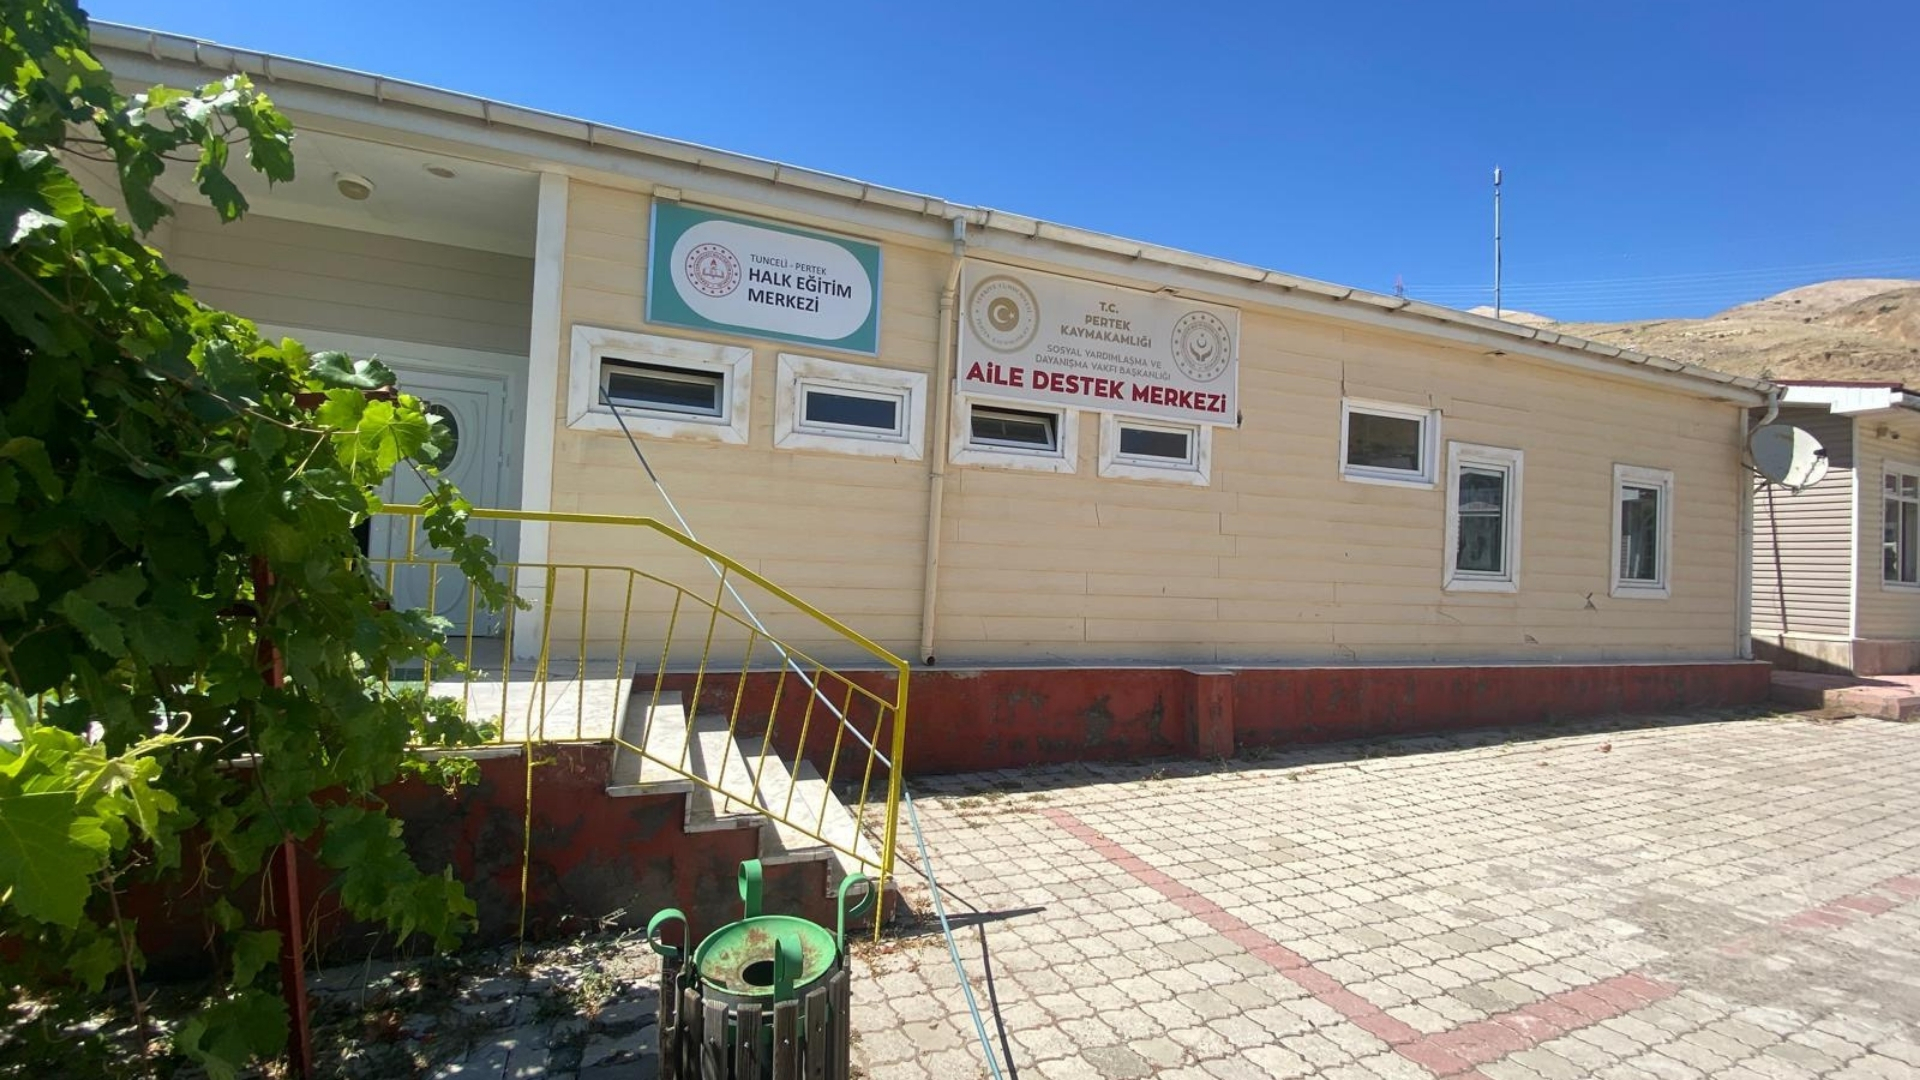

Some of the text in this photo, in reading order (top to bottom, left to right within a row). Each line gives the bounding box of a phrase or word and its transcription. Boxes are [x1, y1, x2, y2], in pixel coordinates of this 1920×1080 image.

[750, 253, 788, 268] TUNCELİ
[795, 262, 827, 275] PERTEK
[749, 267, 792, 289] HALK
[797, 275, 852, 299] EĞİTİM
[748, 288, 819, 313] MERKEZİ
[1099, 301, 1119, 314] T.C.
[1085, 314, 1131, 331] PERTEK
[1060, 324, 1152, 349] KAYMAKAMLIĞI
[1035, 354, 1171, 381] DAYANIŞMA VAKFI BAŞKANLIĞI
[1047, 344, 1162, 369] SOSYAL YARDIMLAŞMA VE
[1032, 370, 1125, 400] DESTEK
